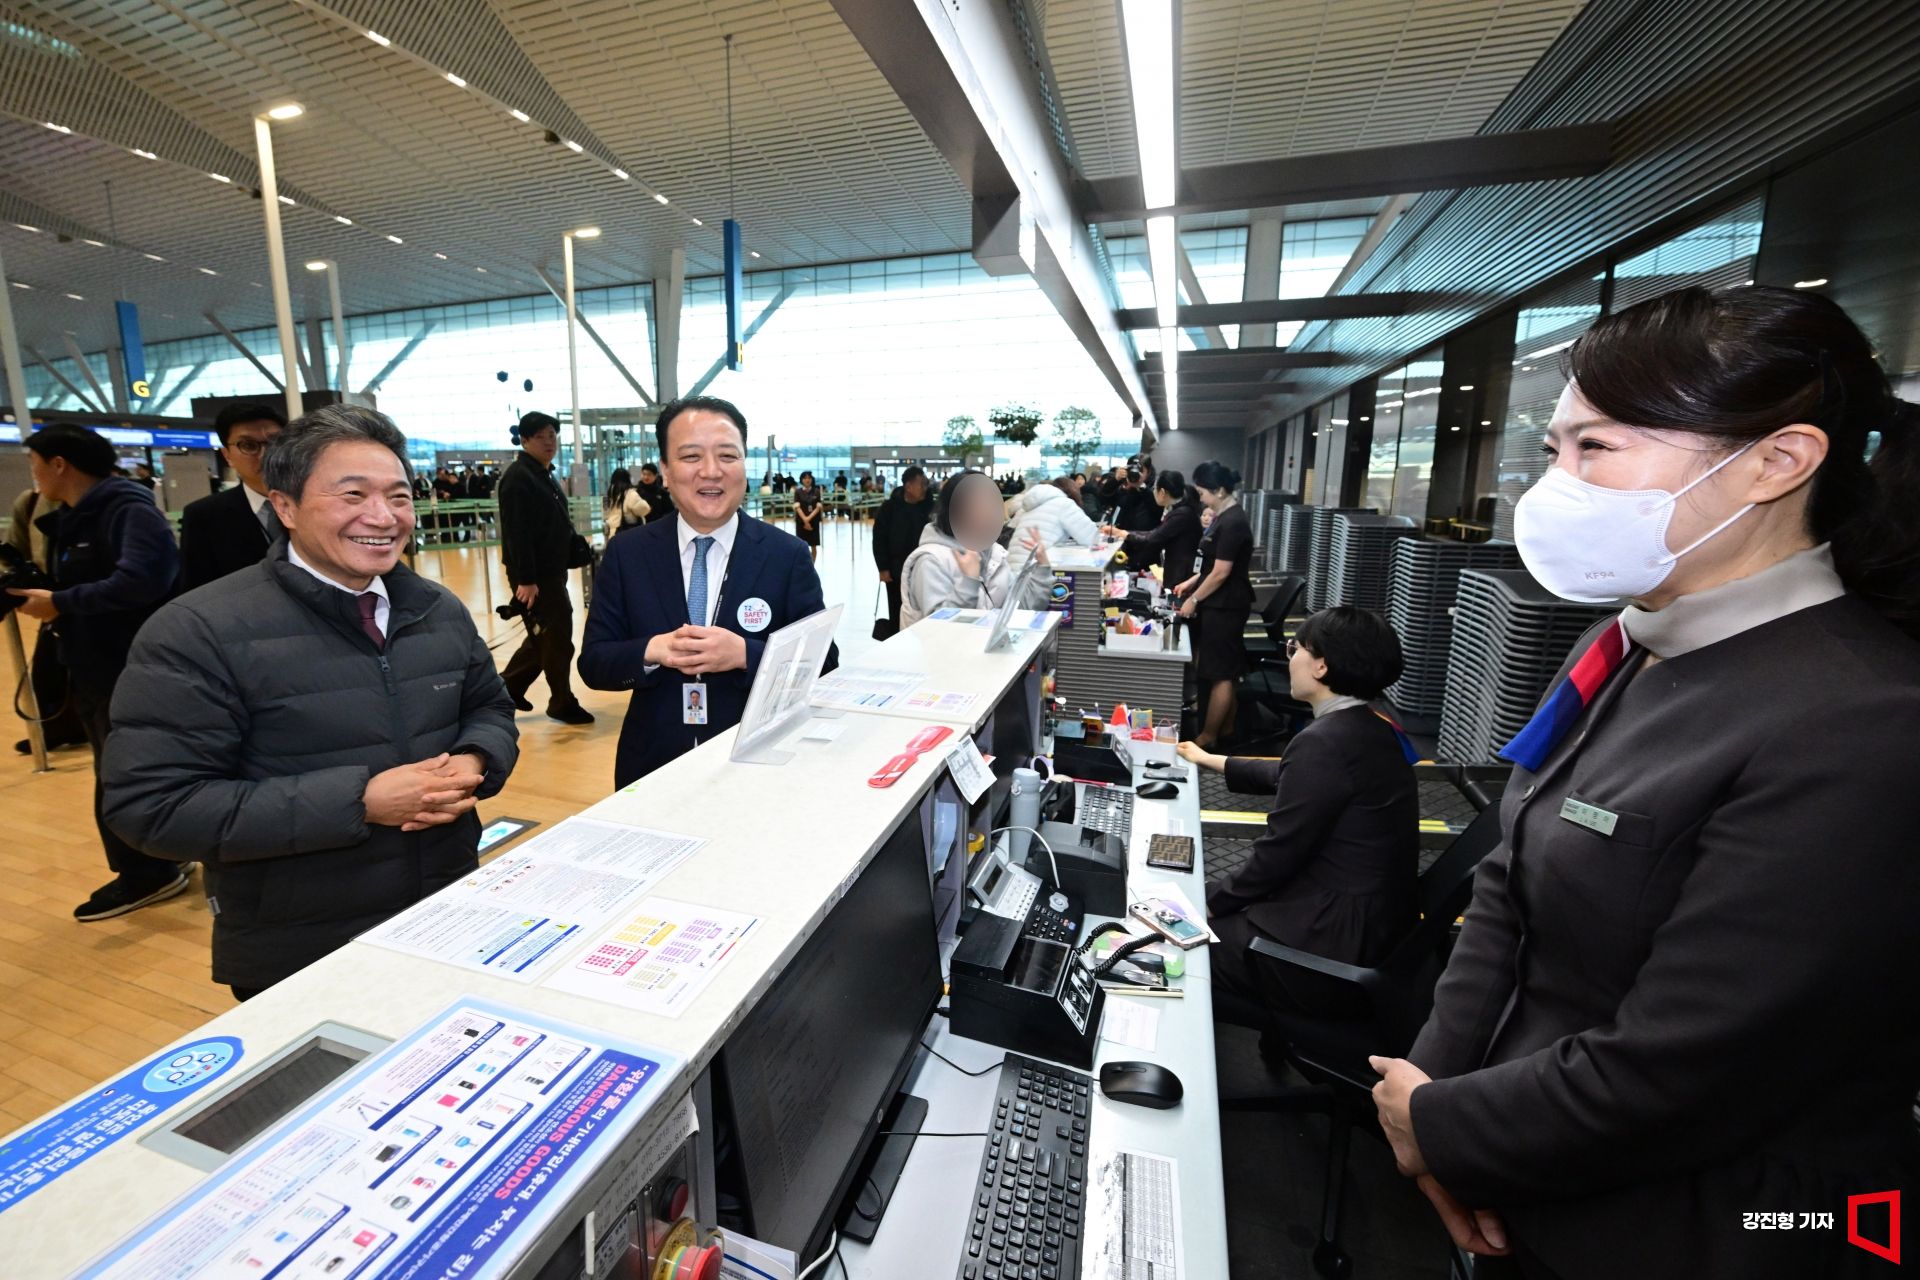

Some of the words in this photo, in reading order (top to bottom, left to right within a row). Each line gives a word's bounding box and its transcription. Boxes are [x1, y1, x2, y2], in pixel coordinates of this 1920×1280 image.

[133, 380, 150, 398] G
[546, 1063, 629, 1142] DANGEROUS
[492, 1144, 553, 1199] GOODS
[466, 1206, 519, 1250] 부치는
